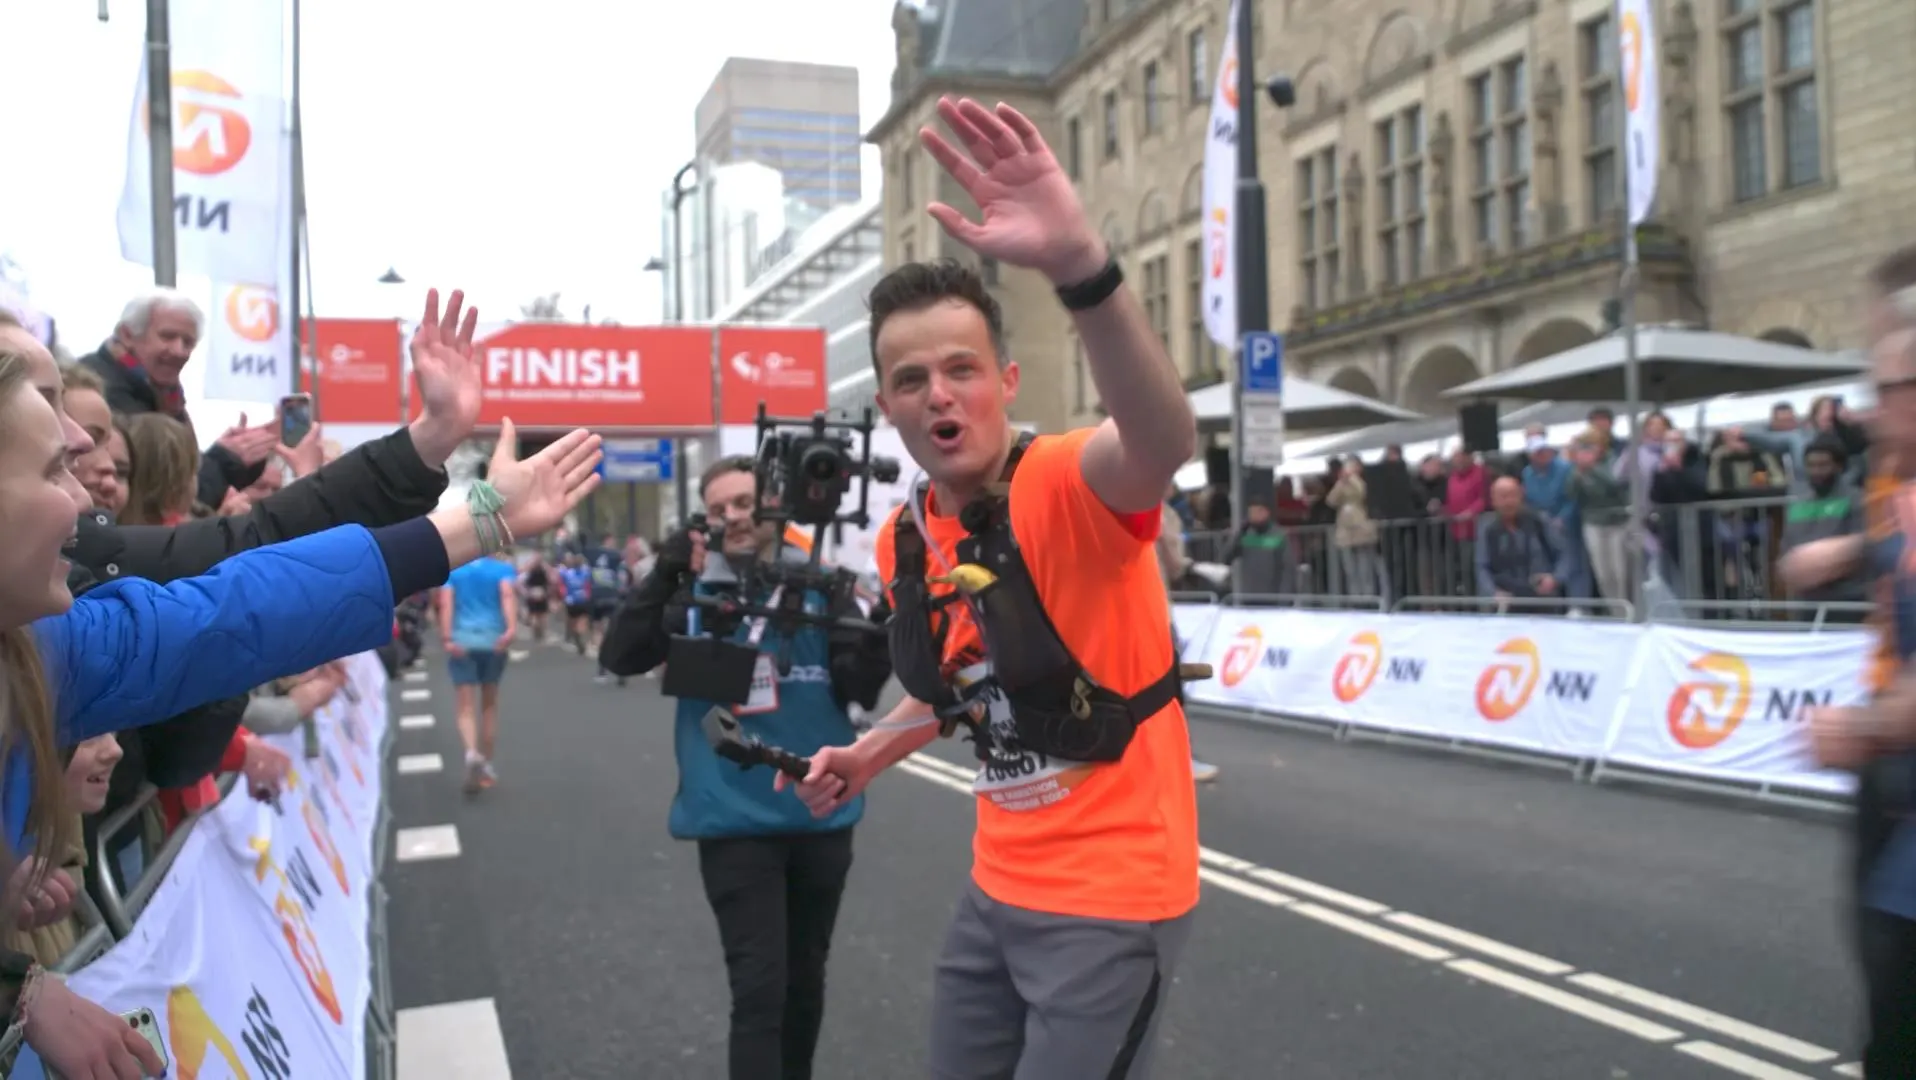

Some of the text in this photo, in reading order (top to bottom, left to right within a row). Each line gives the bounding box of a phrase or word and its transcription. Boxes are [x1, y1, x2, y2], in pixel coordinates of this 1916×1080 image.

[487, 347, 640, 386] FINISH
[1252, 337, 1274, 369] P
[1263, 647, 1289, 668] NN
[1386, 658, 1425, 683] NN
[1546, 671, 1595, 701] NN
